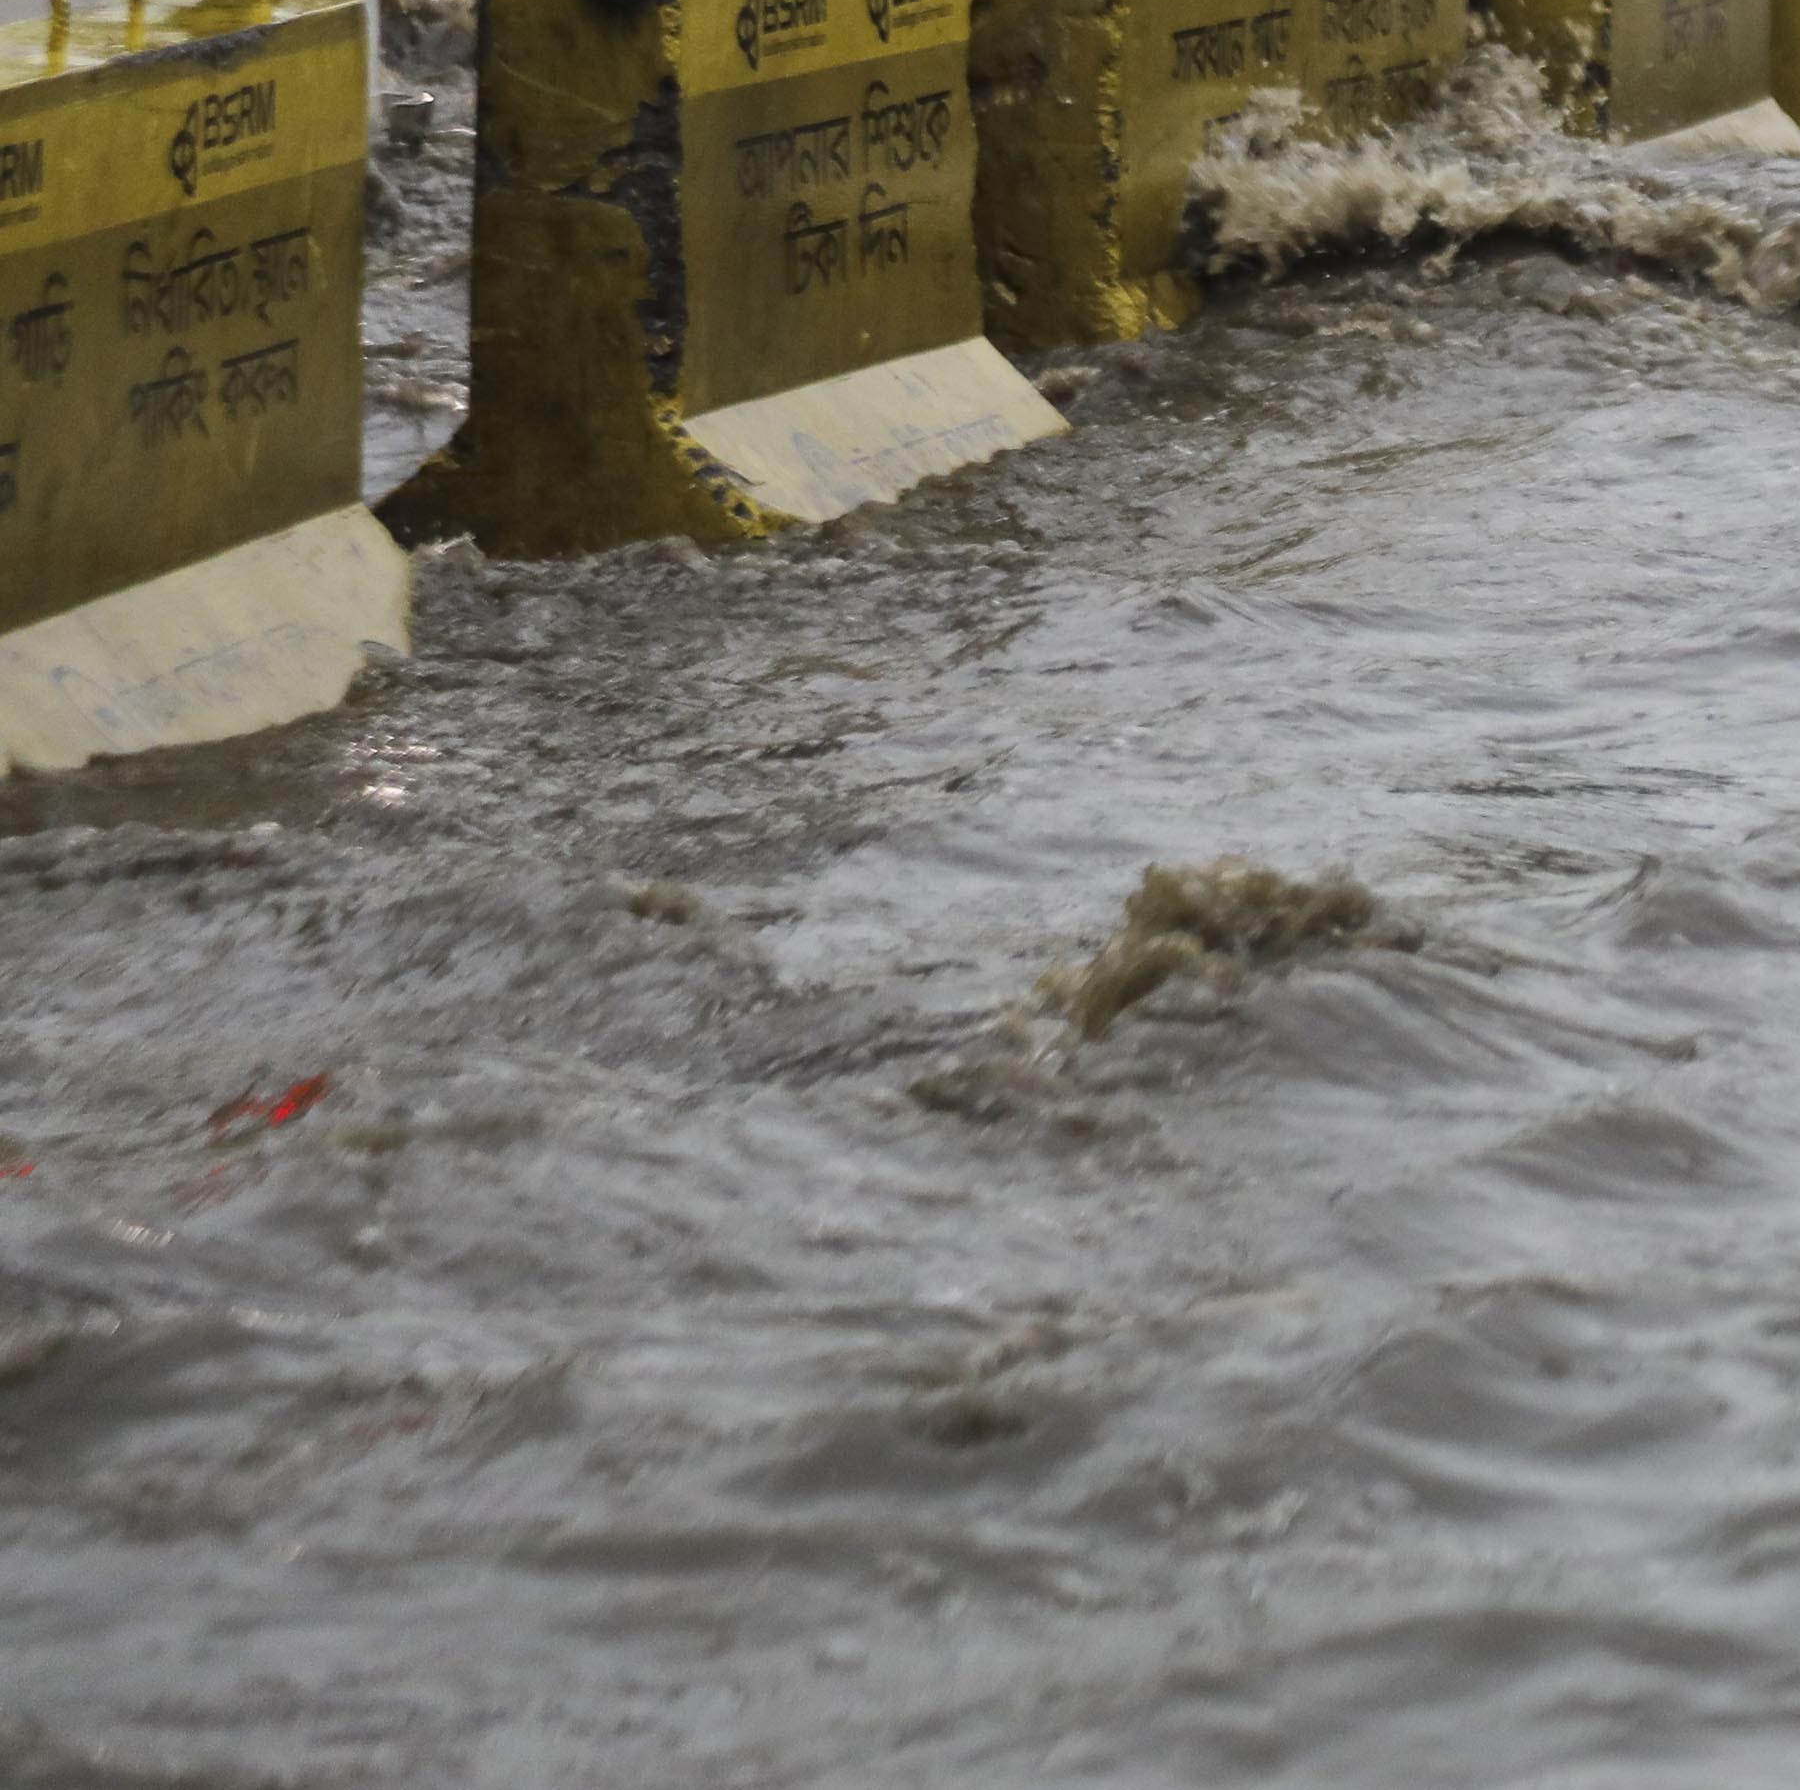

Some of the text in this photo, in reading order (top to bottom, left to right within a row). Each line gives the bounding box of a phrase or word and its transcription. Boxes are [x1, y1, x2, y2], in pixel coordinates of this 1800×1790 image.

[202, 79, 277, 150] BSRM
[735, 115, 851, 200] আপনার
[858, 181, 909, 275] দিন
